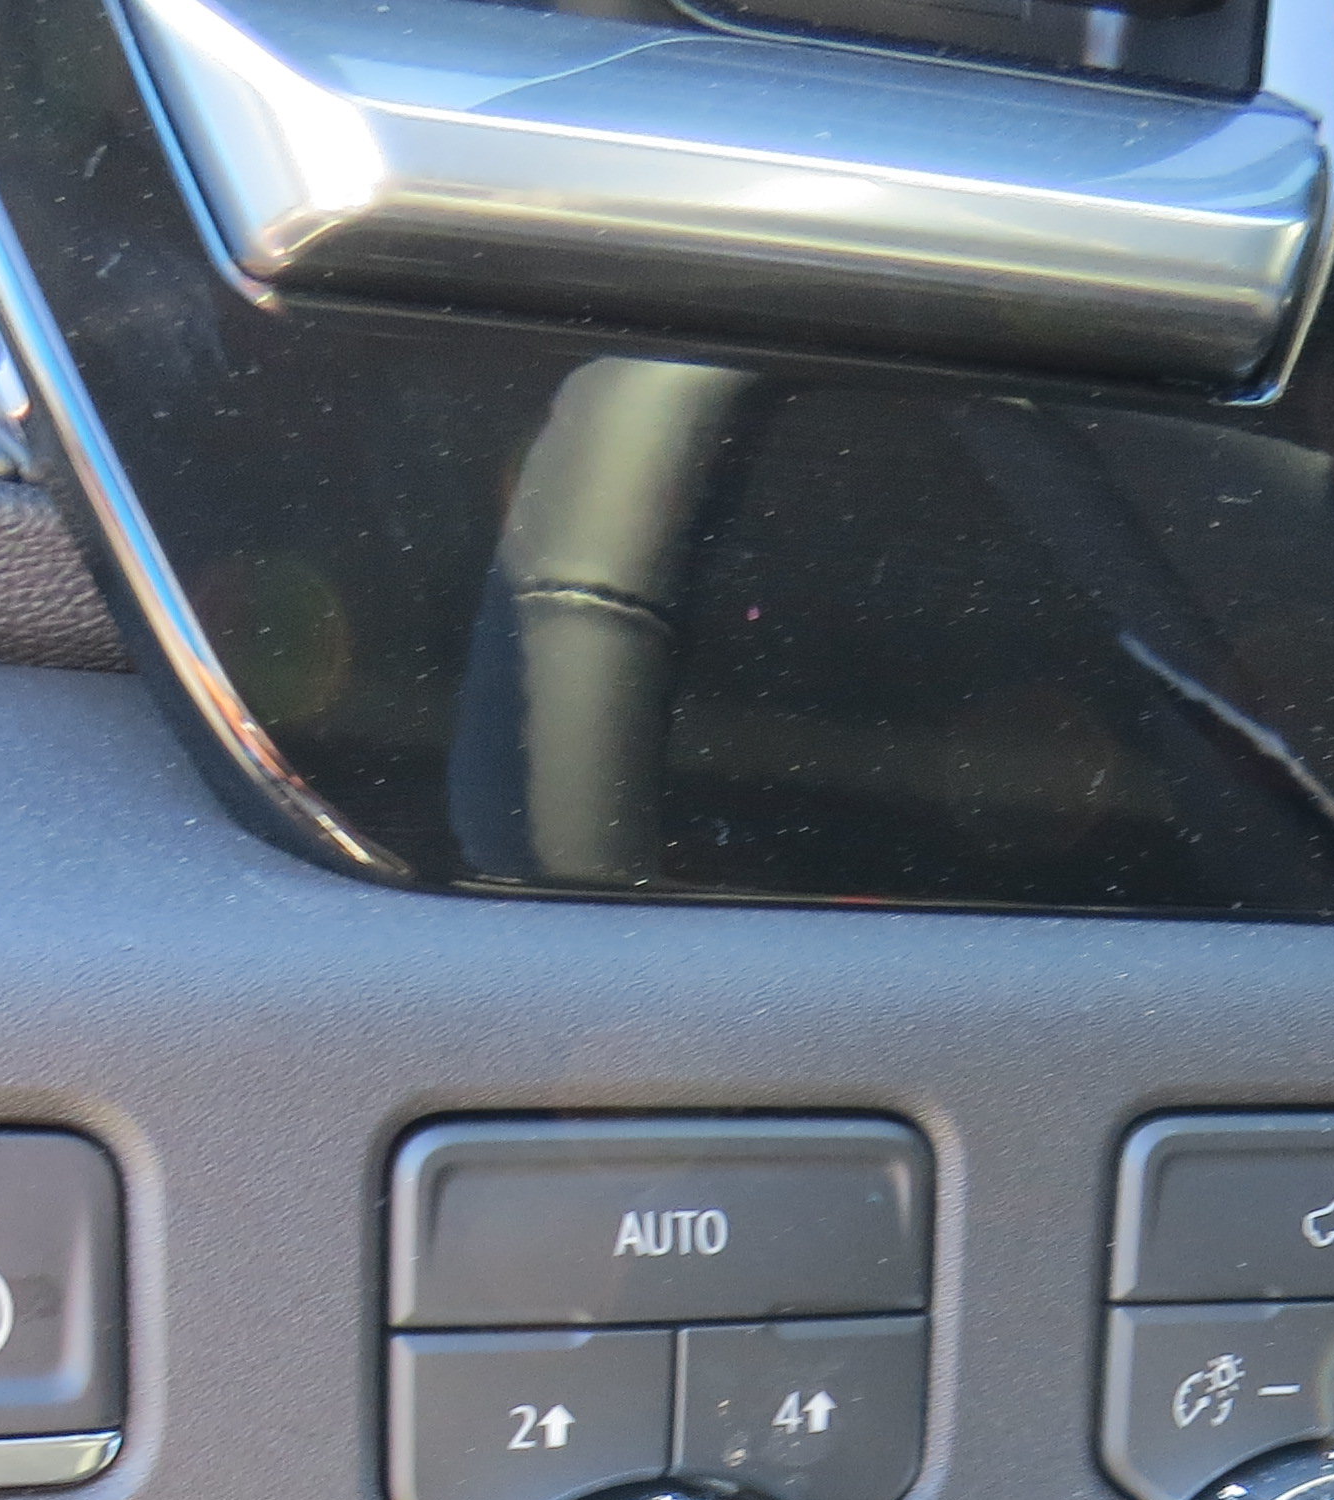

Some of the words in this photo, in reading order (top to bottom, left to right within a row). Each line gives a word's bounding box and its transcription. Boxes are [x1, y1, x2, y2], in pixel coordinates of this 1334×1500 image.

[613, 1208, 730, 1258] AUTO
[507, 1404, 537, 1451] 2
[771, 1391, 803, 1435] 4
